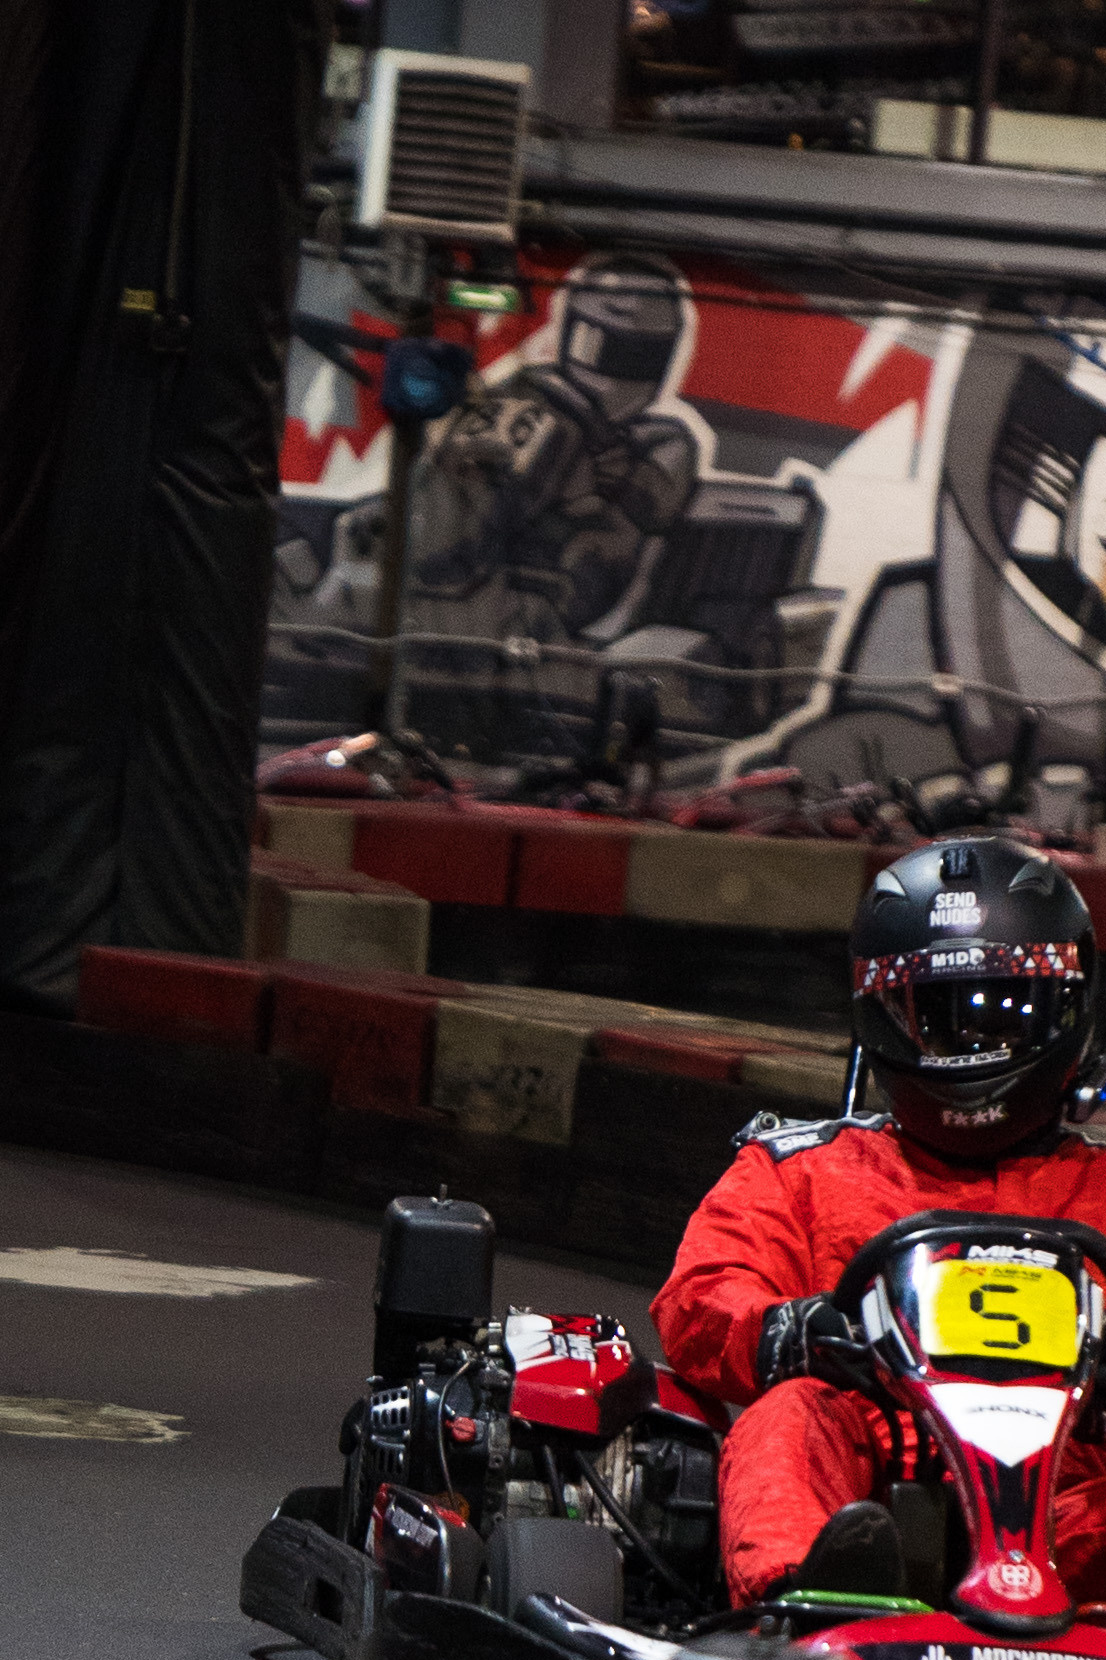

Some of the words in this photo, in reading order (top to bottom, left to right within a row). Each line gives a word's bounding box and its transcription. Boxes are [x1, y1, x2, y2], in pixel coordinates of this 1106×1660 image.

[934, 891, 977, 909] SEND
[929, 907, 982, 927] NUDES
[967, 1244, 1060, 1267] MIKS
